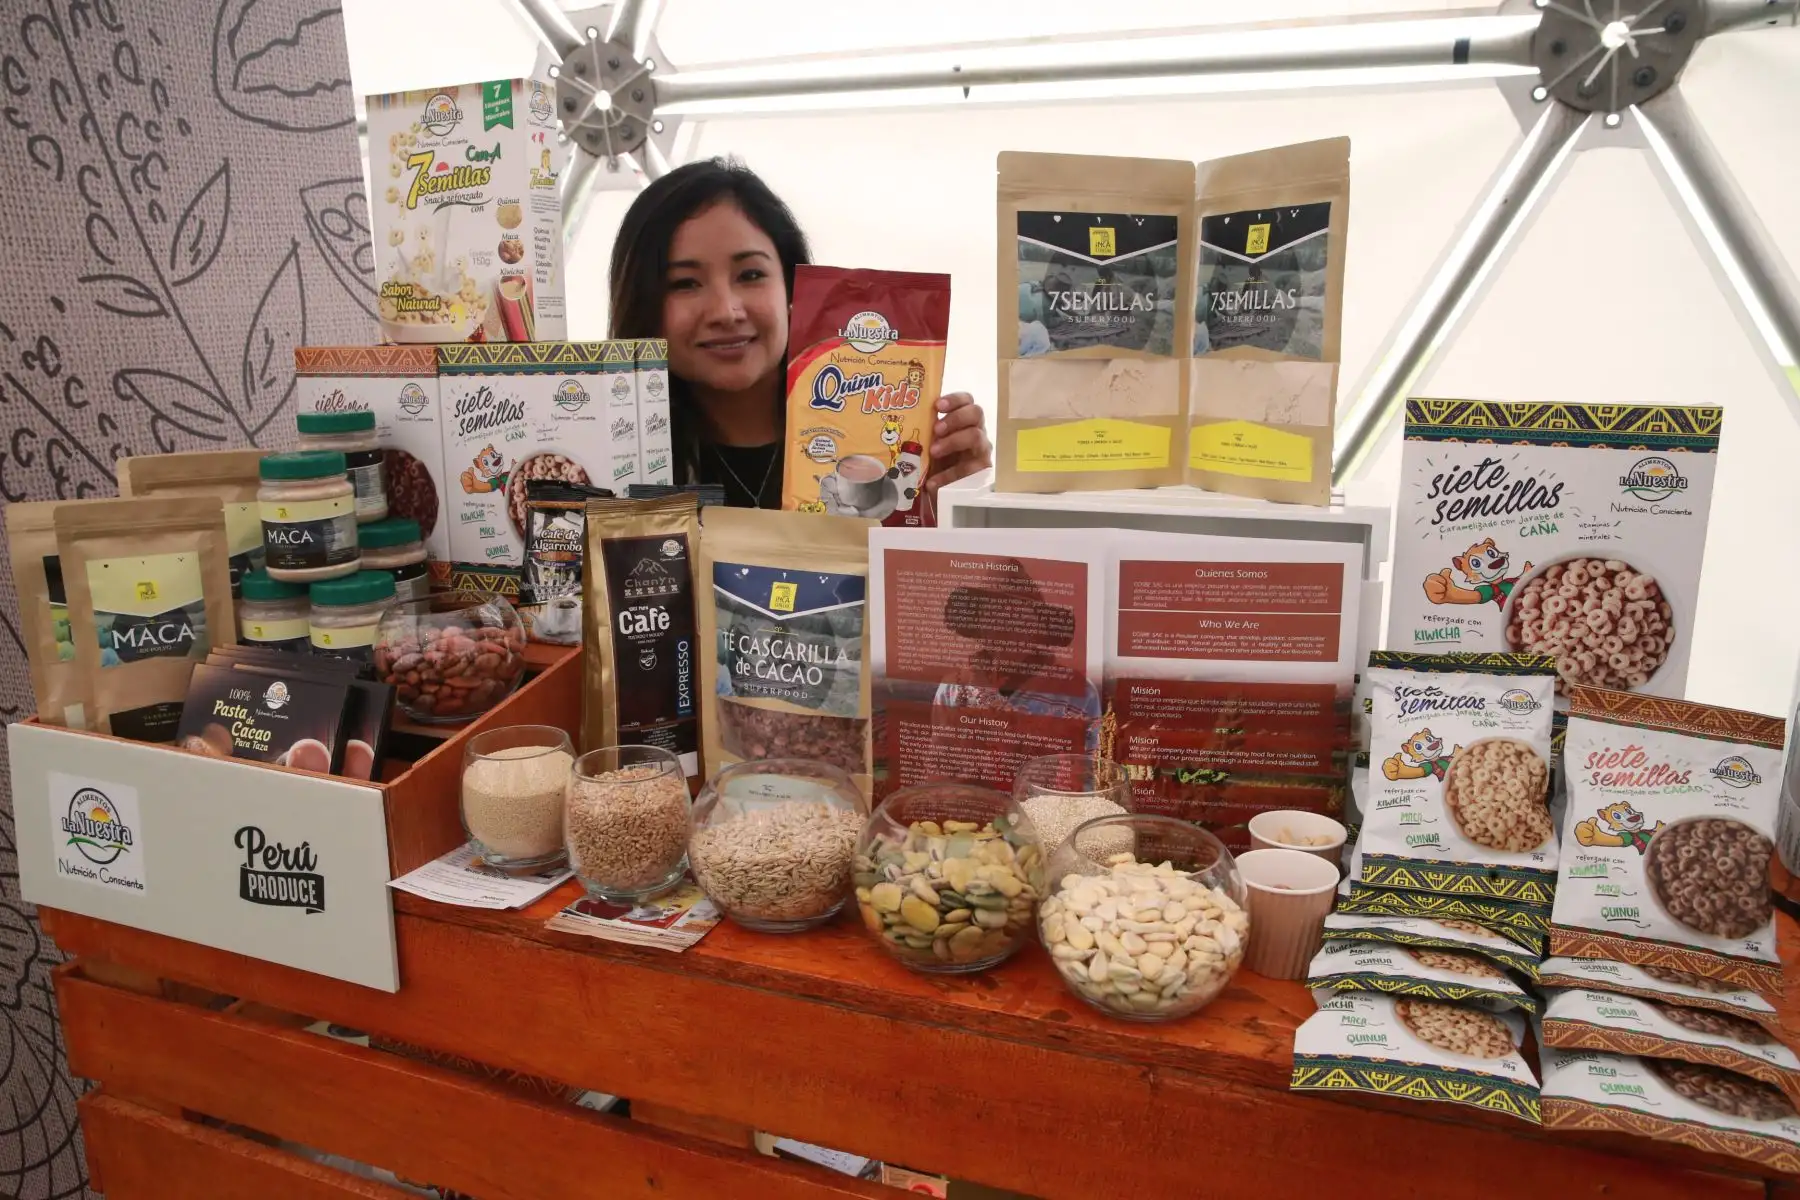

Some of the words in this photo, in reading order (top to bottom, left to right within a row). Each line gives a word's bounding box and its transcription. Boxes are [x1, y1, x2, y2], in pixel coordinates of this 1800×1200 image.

[492, 84, 502, 98] 7
[407, 150, 435, 210] 7
[417, 165, 491, 196] Semillas
[424, 195, 446, 206] Snack
[497, 197, 520, 206] Quinua
[471, 205, 485, 213] con
[500, 268, 525, 276] Kiwicha
[381, 282, 413, 298] Sabor
[397, 295, 441, 312] Natural
[1068, 315, 1136, 324] SUPERFOOD
[830, 352, 866, 365] Nutrición
[867, 354, 911, 366] Consciente
[454, 385, 496, 418] siete
[862, 381, 920, 413] Kids
[458, 399, 525, 437] semillas
[1638, 459, 1671, 470] ALIMENTOS
[1427, 457, 1510, 499] siete
[1431, 477, 1565, 525] semillas
[1610, 502, 1648, 514] Nutrición
[1650, 504, 1693, 516] Consciente
[1439, 520, 1498, 534] Caramelizado
[1500, 518, 1515, 526] con
[1518, 512, 1551, 525] Jarabe
[1553, 511, 1565, 519] de
[1519, 520, 1559, 538] CAÑA
[267, 529, 314, 544] MACA
[541, 529, 564, 540] Café
[565, 529, 579, 540] de
[1578, 533, 1611, 541] minerales
[532, 539, 582, 553] Algarrobo
[950, 559, 984, 570] Nuestra
[985, 562, 1019, 573] Historia
[1195, 568, 1234, 578] Quienes
[1236, 569, 1268, 579] Somos
[1200, 620, 1222, 629] Who
[1224, 620, 1240, 629] We
[1242, 620, 1260, 630] Are
[1423, 614, 1465, 625] reforzado
[111, 622, 197, 650] MACA
[1414, 626, 1461, 641] KIWICHA
[738, 634, 849, 665] CASCARILLA
[678, 640, 690, 708] EXPRESSO
[736, 656, 751, 676] de
[755, 660, 823, 686] CACAO
[228, 688, 252, 702] 100%
[743, 682, 808, 699] SUPERFOOD
[1131, 686, 1161, 695] Misión
[213, 699, 248, 719] Pasta
[1397, 695, 1486, 718] semillas
[246, 716, 255, 725] de
[959, 715, 977, 724] Our
[978, 718, 1009, 729] History
[231, 721, 272, 742] Cacao
[234, 738, 251, 748] Para
[252, 740, 269, 752] Taza
[1584, 744, 1650, 770] siete
[1589, 763, 1693, 787] semillas
[1132, 787, 1155, 796] isión
[1663, 785, 1703, 795] CACAO
[77, 793, 111, 813] ALIMENTOS
[1377, 795, 1411, 808] KIWICHA
[1400, 812, 1423, 822] MACA
[1406, 833, 1440, 845] QUINUA
[234, 826, 318, 871] Perú
[1576, 855, 1610, 864] reforzado
[58, 857, 98, 880] Nutrición
[99, 867, 144, 890] Consciente
[1569, 864, 1608, 876] KIWICHA
[248, 873, 317, 905] PRODUCE
[1595, 883, 1621, 894] MACA
[1601, 906, 1640, 919] QUINUA
[1355, 958, 1392, 966] QUINUA
[1586, 993, 1613, 1003] MACA
[1597, 1006, 1639, 1017] QUINUA
[1341, 1015, 1367, 1026] MACA
[1347, 1034, 1388, 1043] QUINUA
[1588, 1064, 1616, 1076] MACA
[1600, 1082, 1644, 1095] QUINUA
